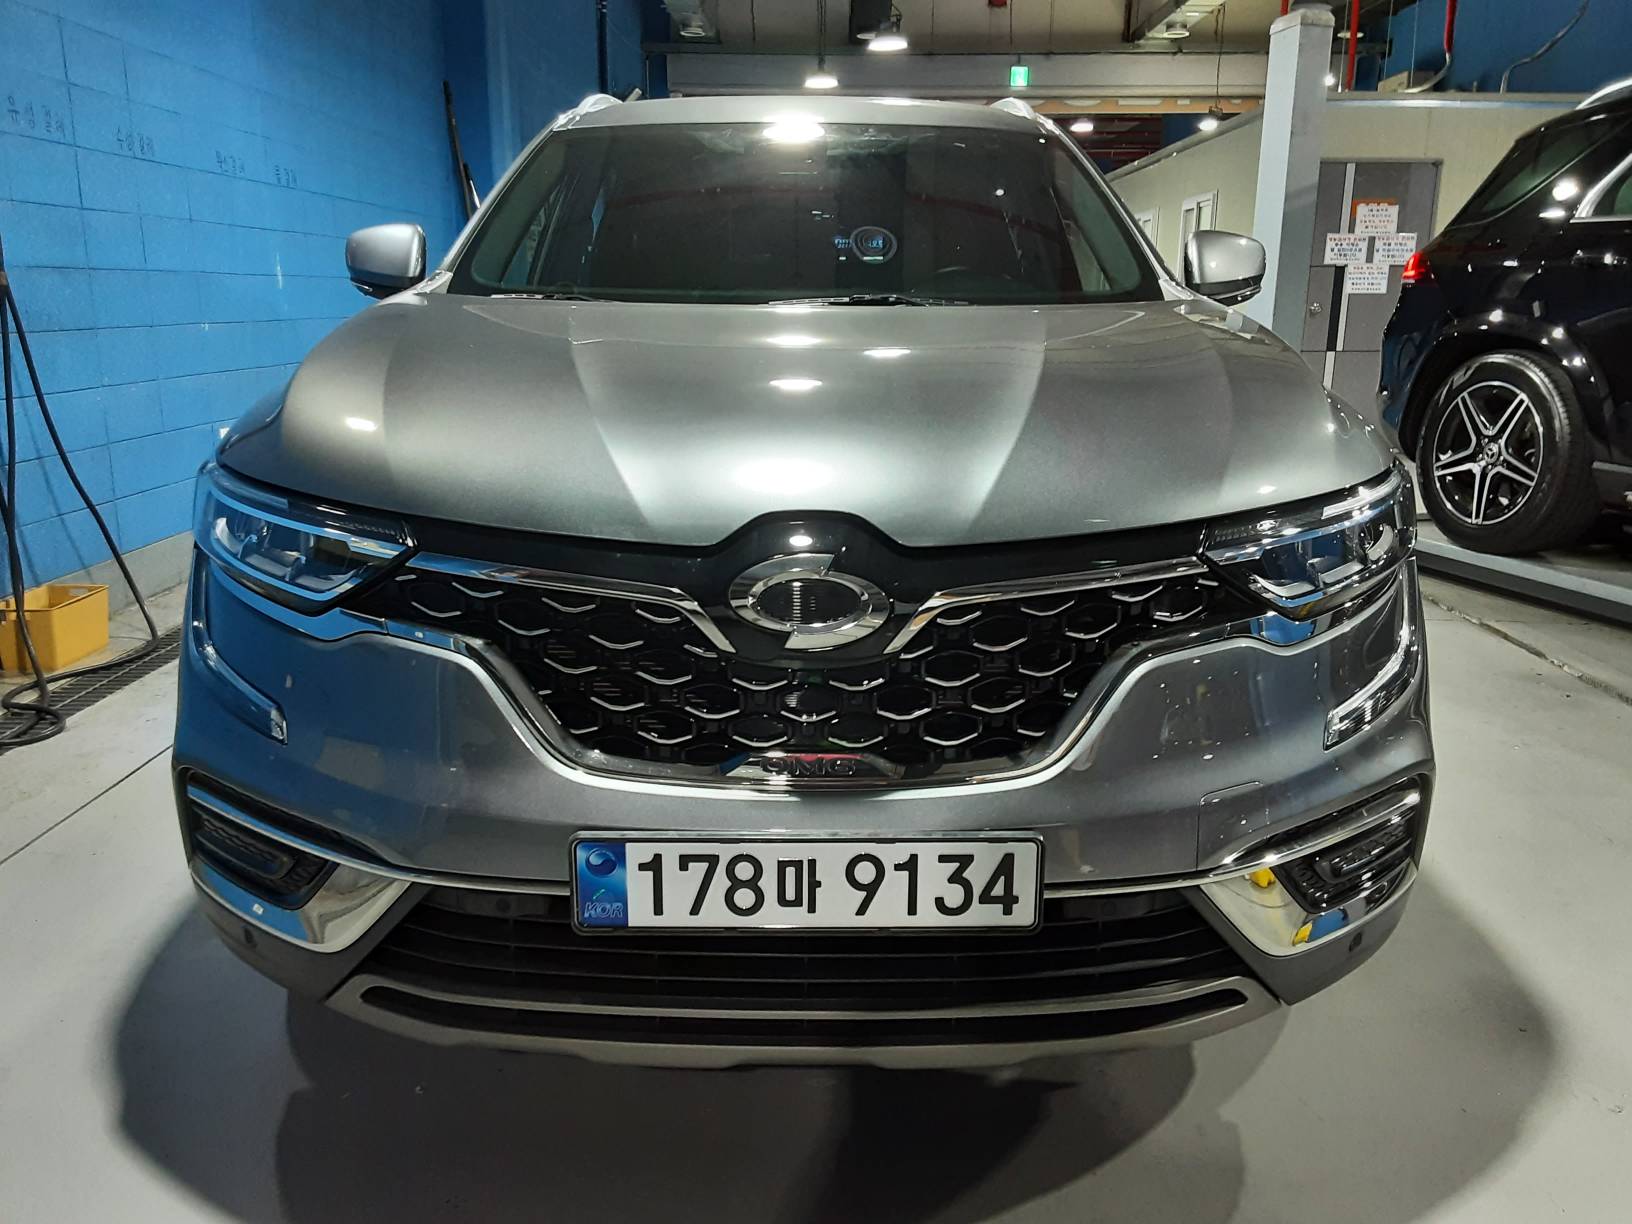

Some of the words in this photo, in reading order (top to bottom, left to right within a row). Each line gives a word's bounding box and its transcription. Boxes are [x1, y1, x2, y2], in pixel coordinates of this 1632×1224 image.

[638, 852, 822, 917] 178마
[844, 852, 1020, 917] 9134
[584, 902, 624, 919] KOR
